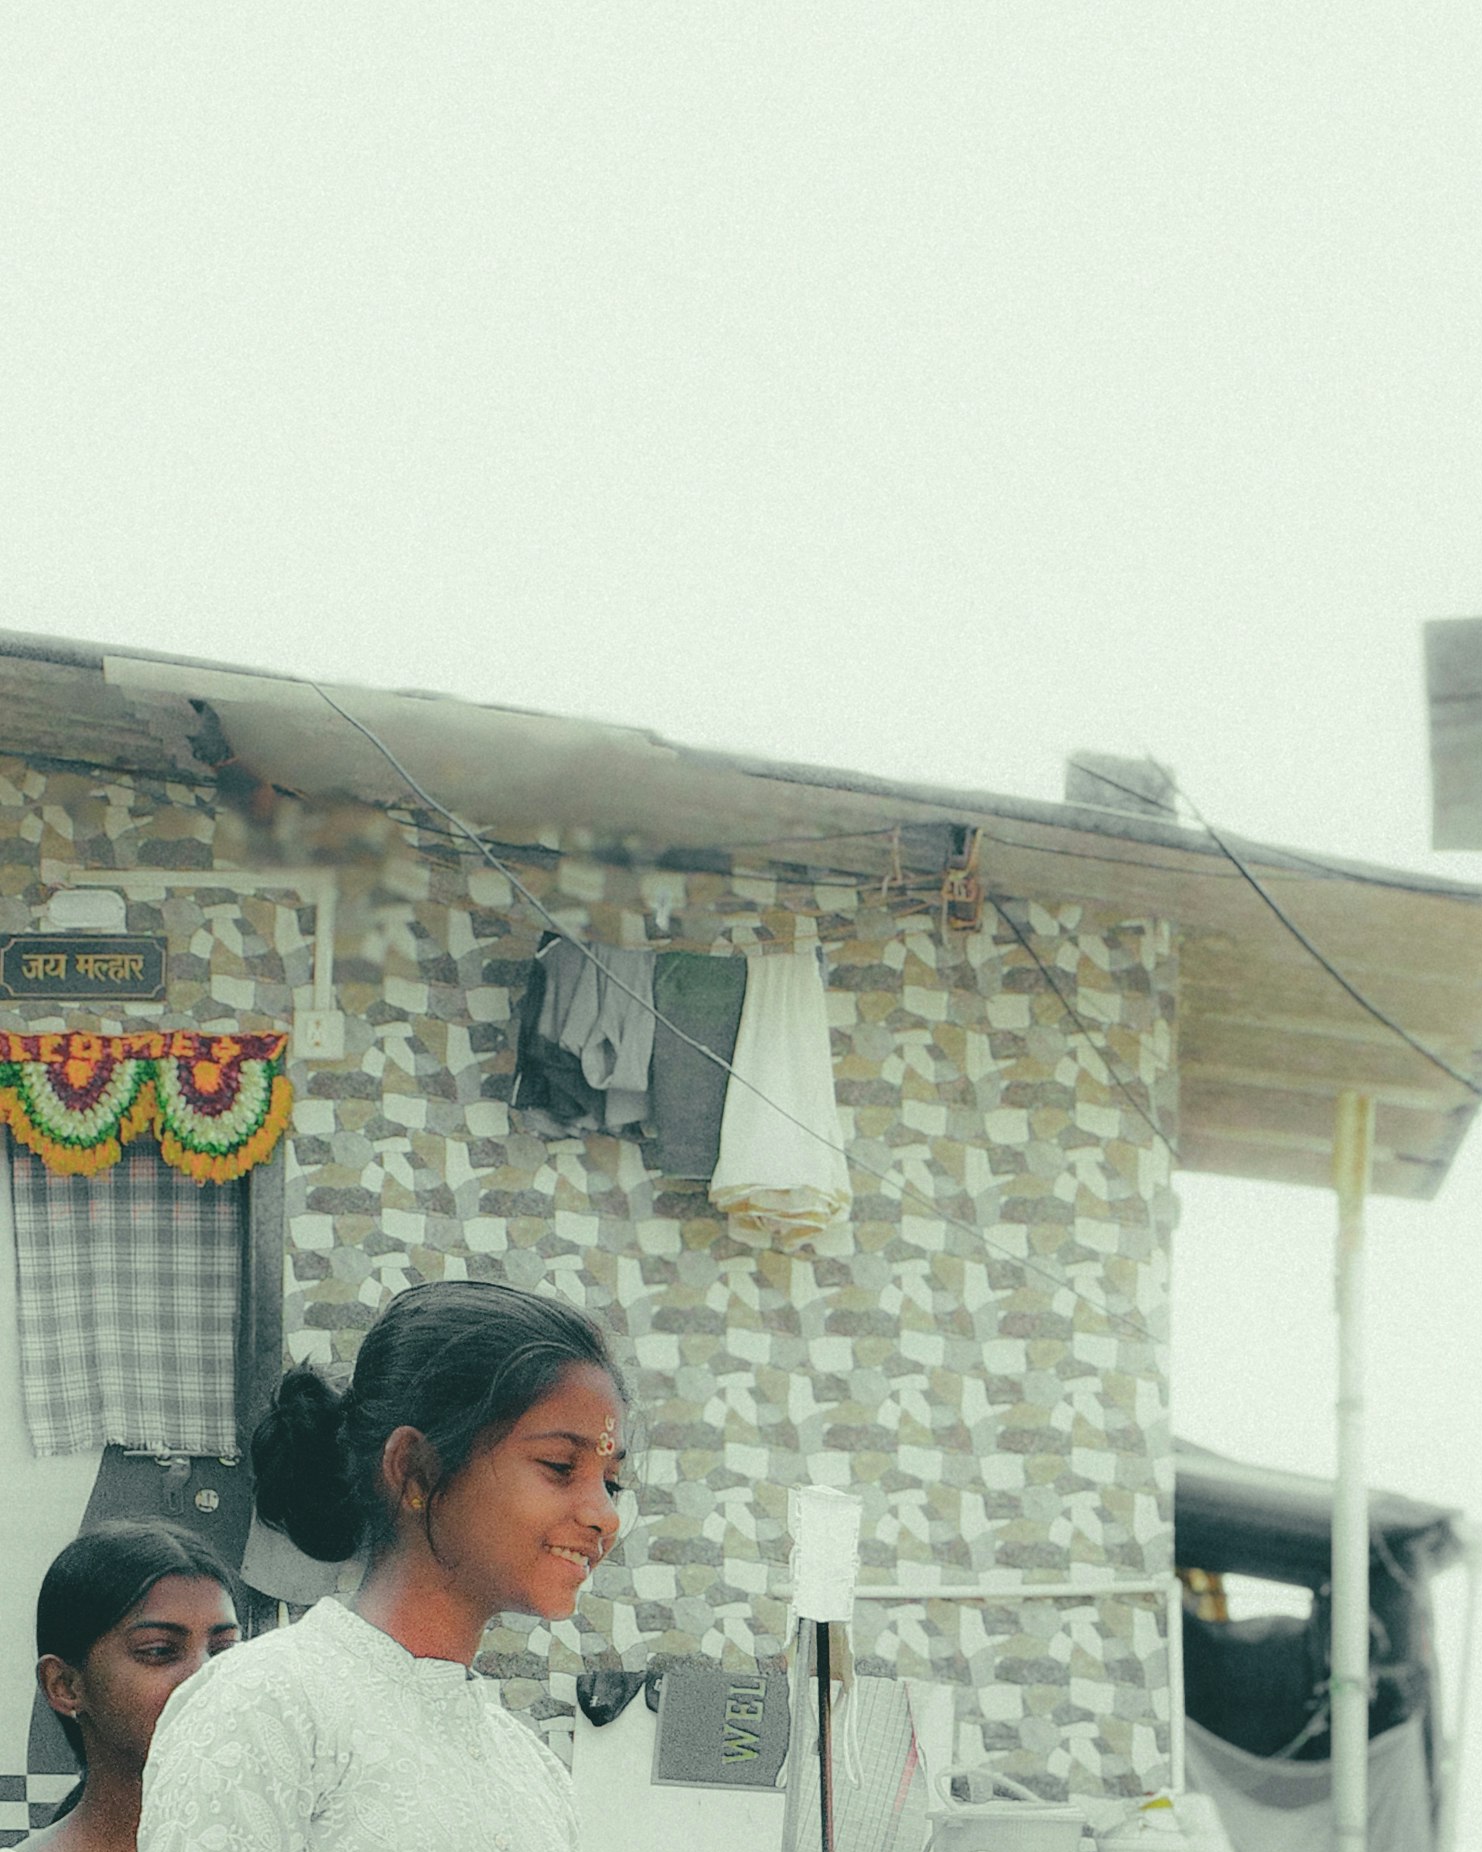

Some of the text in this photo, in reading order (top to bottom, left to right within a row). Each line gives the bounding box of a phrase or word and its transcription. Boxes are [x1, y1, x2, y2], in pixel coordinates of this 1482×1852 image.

[22, 954, 145, 984] जय मल्हार
[0, 1032, 196, 1063] LCOME
